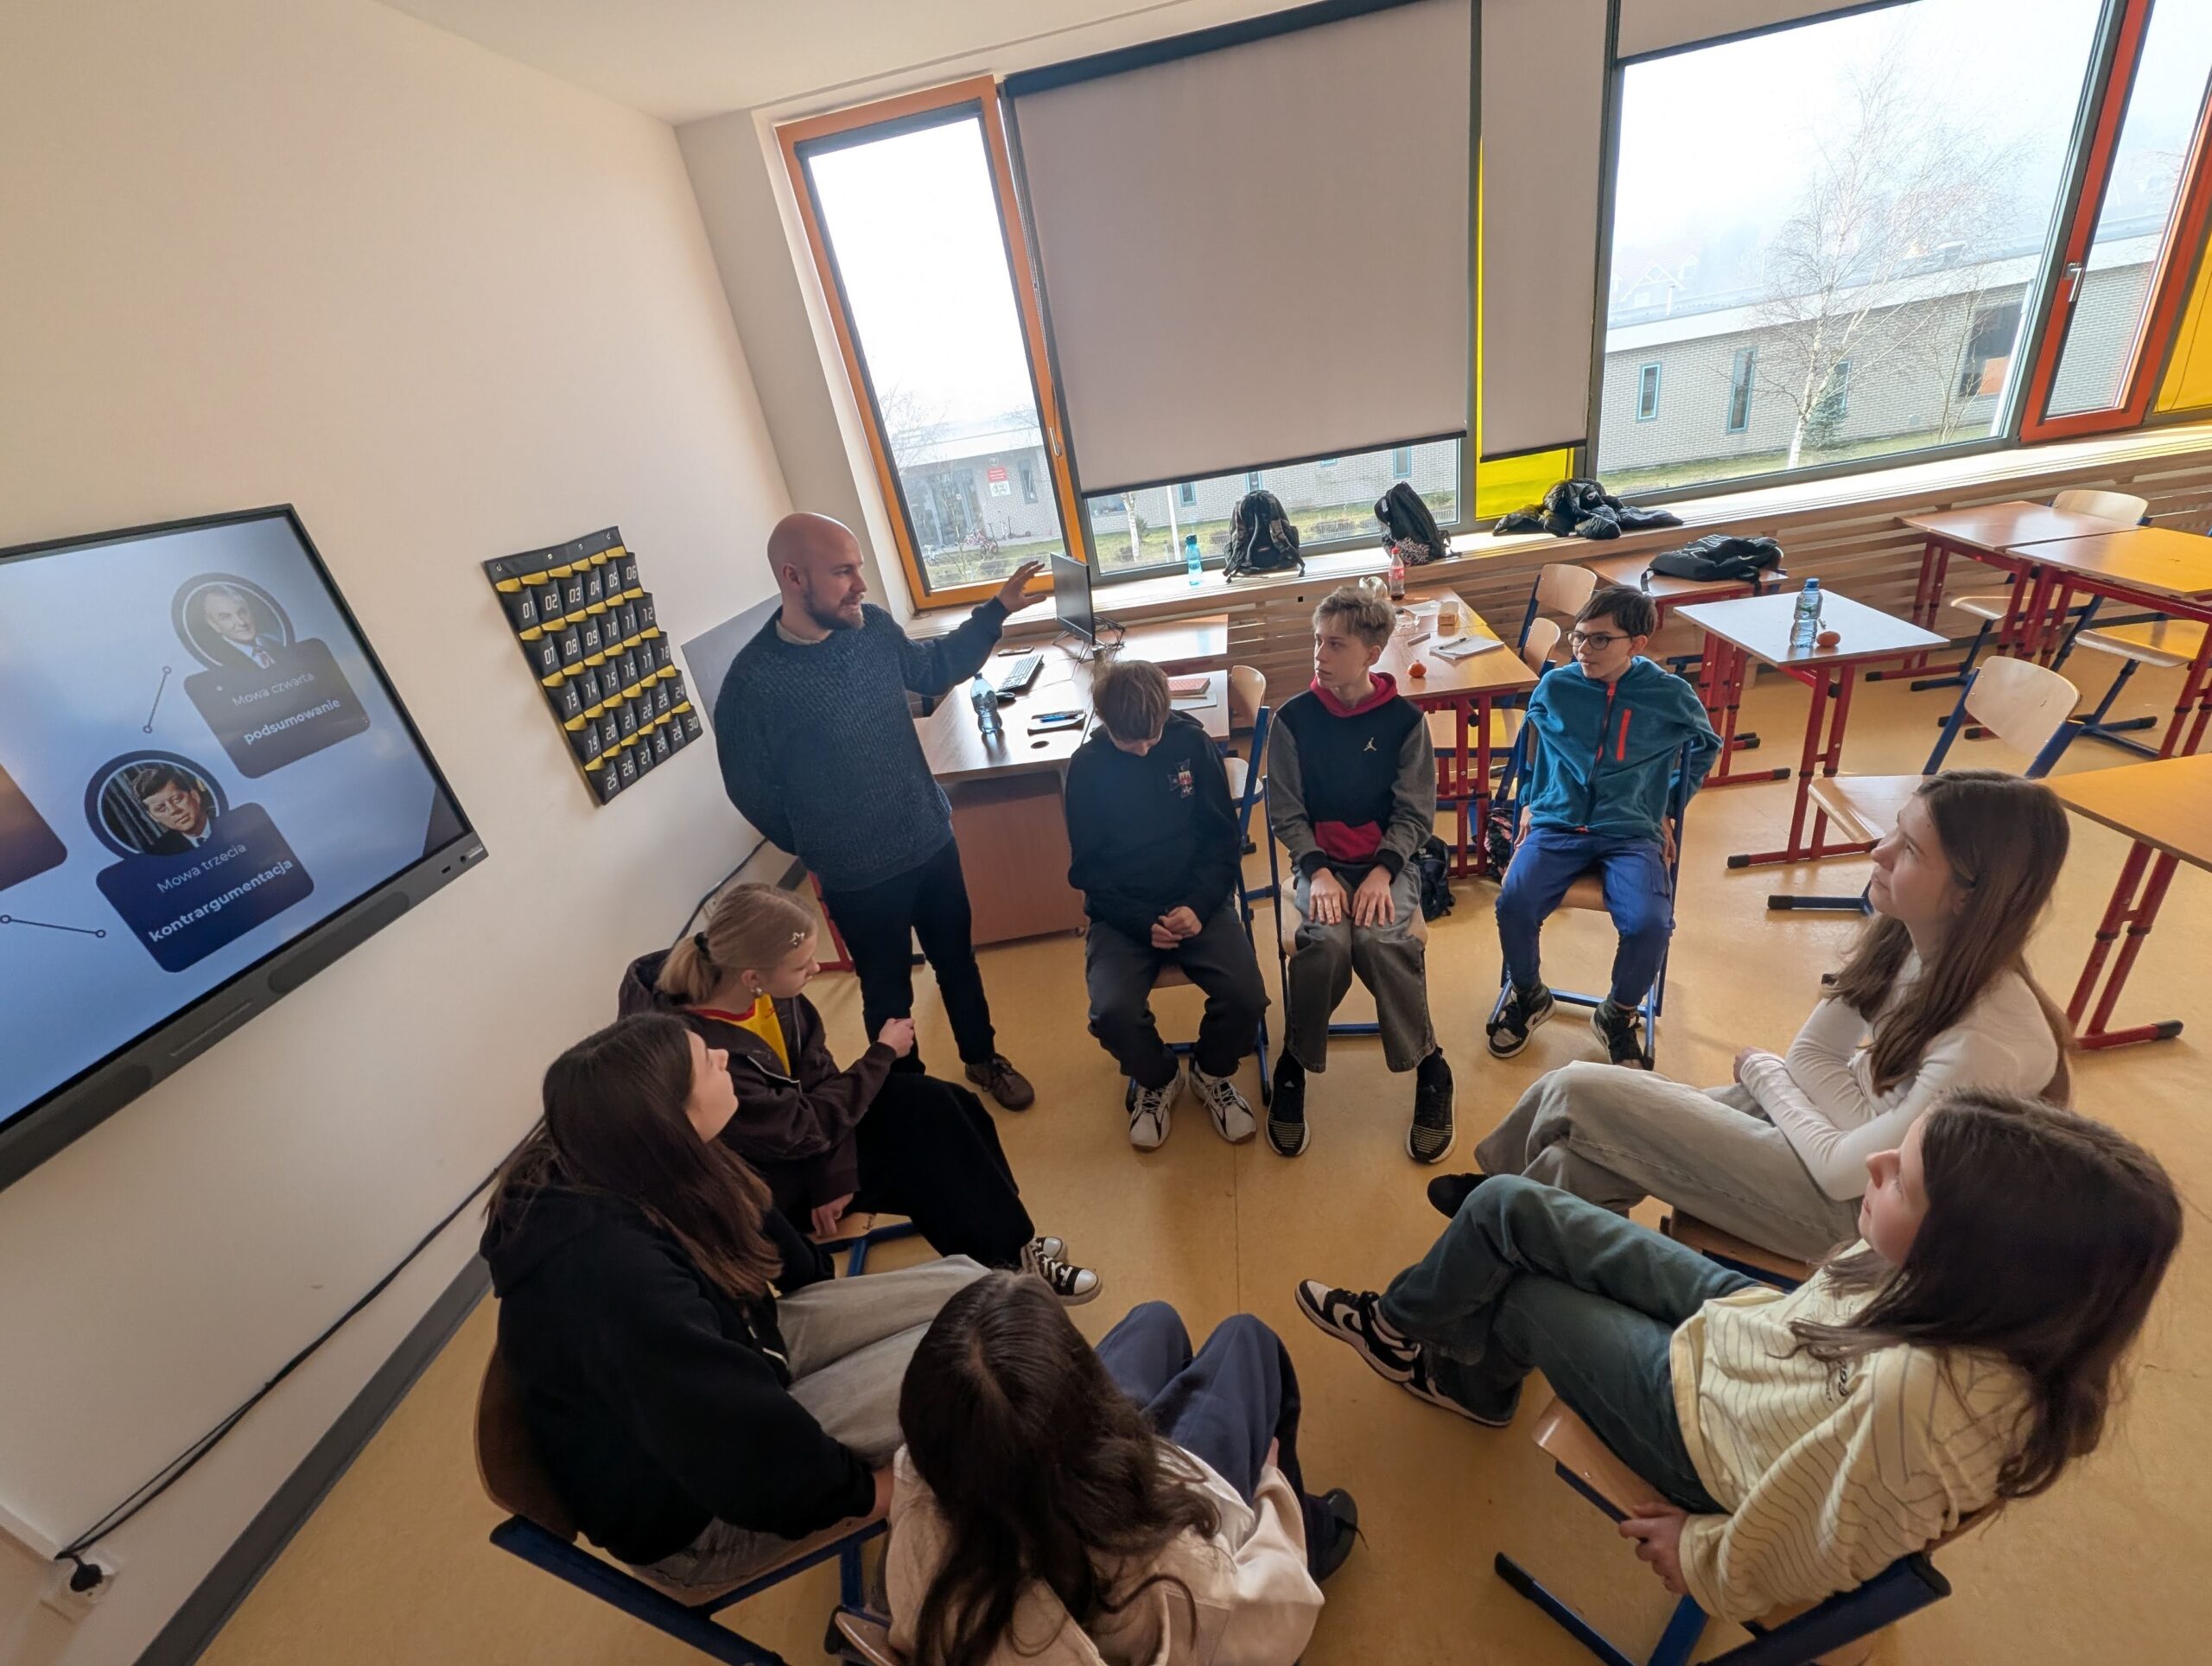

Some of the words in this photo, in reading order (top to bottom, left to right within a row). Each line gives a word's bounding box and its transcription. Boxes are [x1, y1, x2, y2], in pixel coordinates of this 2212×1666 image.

[523, 601, 534, 618] 01
[545, 595, 557, 610] 02
[569, 588, 581, 602] 03
[590, 580, 600, 595] 04
[609, 572, 618, 588] 05
[626, 566, 637, 580] 06
[544, 646, 555, 664] 07
[566, 639, 577, 655] 08
[587, 630, 598, 645] 09
[607, 622, 617, 638] 10
[626, 614, 634, 629] 11
[643, 607, 653, 621] 12
[232, 689, 270, 707] Mowa
[271, 672, 315, 694] czwarta
[567, 691, 577, 709] 13
[586, 681, 596, 698] 14
[607, 672, 616, 689] 15
[625, 662, 635, 678] 16
[643, 653, 652, 668] 17
[660, 645, 669, 660] 18
[244, 699, 341, 746] podsumowanie
[588, 735, 598, 754] 19
[606, 724, 616, 741] 20
[625, 713, 634, 729] 21
[643, 703, 652, 719] 22
[658, 693, 668, 709] 23
[675, 684, 684, 699] 24
[607, 773, 617, 790] 25
[622, 760, 633, 777] 26
[640, 748, 650, 765] 27
[657, 737, 666, 753] 28
[673, 726, 682, 741] 29
[688, 716, 698, 731] 30
[156, 866, 201, 893] Mowa
[200, 843, 247, 871] trzecia
[148, 860, 294, 943] kontrargumentacja
